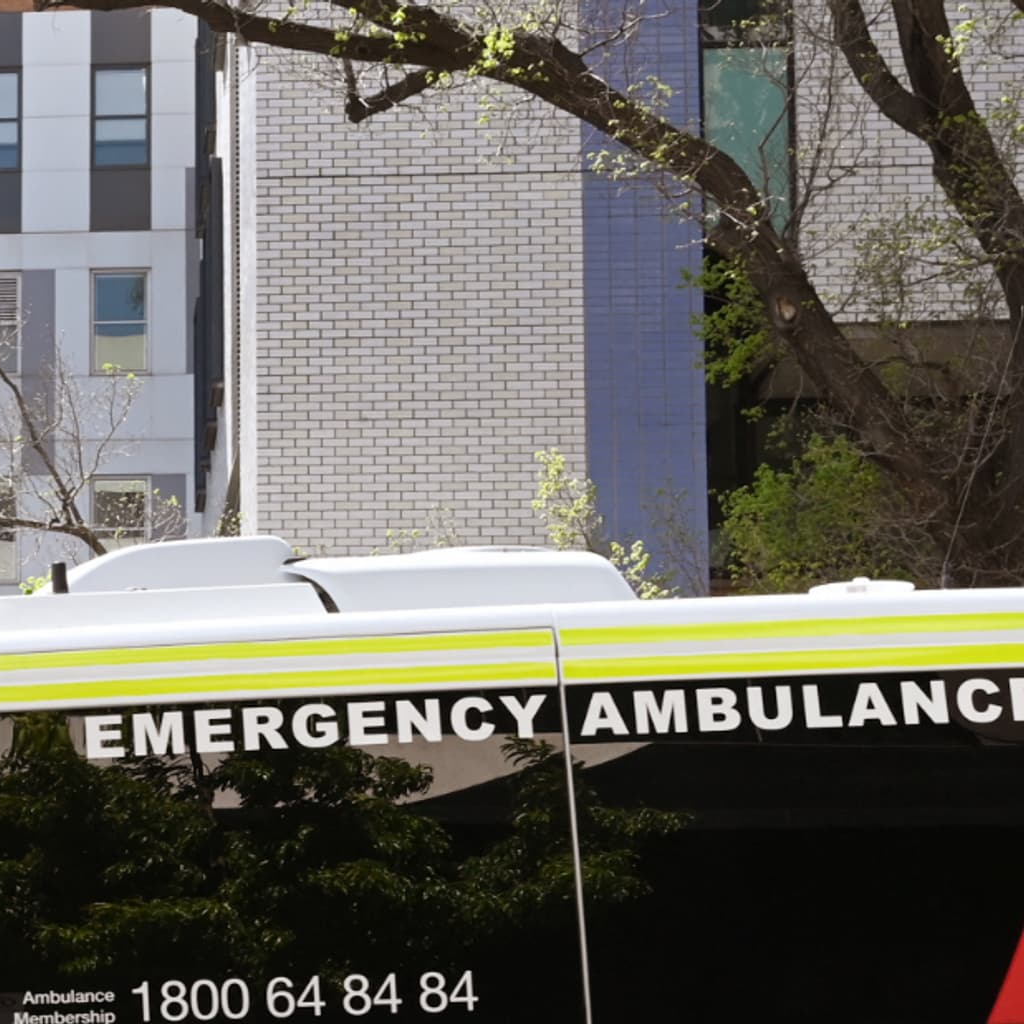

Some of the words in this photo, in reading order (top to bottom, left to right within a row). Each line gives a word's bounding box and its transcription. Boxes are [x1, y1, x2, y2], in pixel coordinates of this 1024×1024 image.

[84, 694, 546, 759] EMERGENCY
[22, 989, 116, 1005] Ambulance
[131, 979, 250, 1022] 1800
[266, 975, 326, 1018] 64
[343, 972, 403, 1015] 84
[419, 970, 479, 1013] 84
